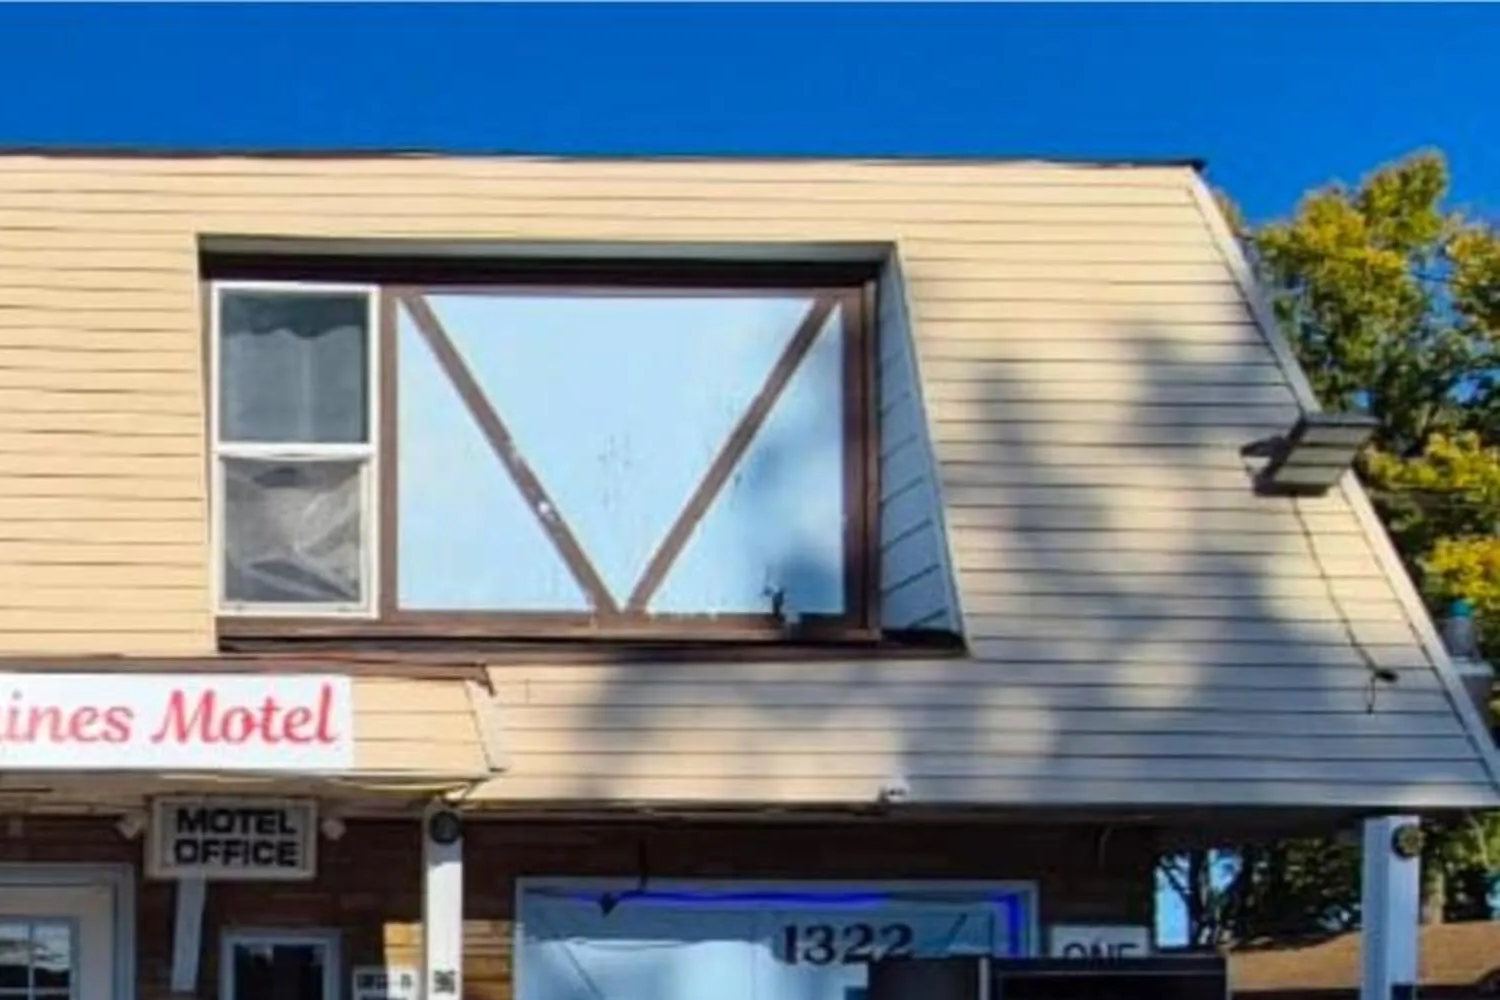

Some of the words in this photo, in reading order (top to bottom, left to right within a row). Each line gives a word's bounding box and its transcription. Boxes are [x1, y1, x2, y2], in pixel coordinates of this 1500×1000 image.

[150, 684, 338, 744] Motel
[176, 808, 297, 834] MOTEL
[173, 838, 298, 867] OFFICE
[783, 923, 914, 966] 1322
